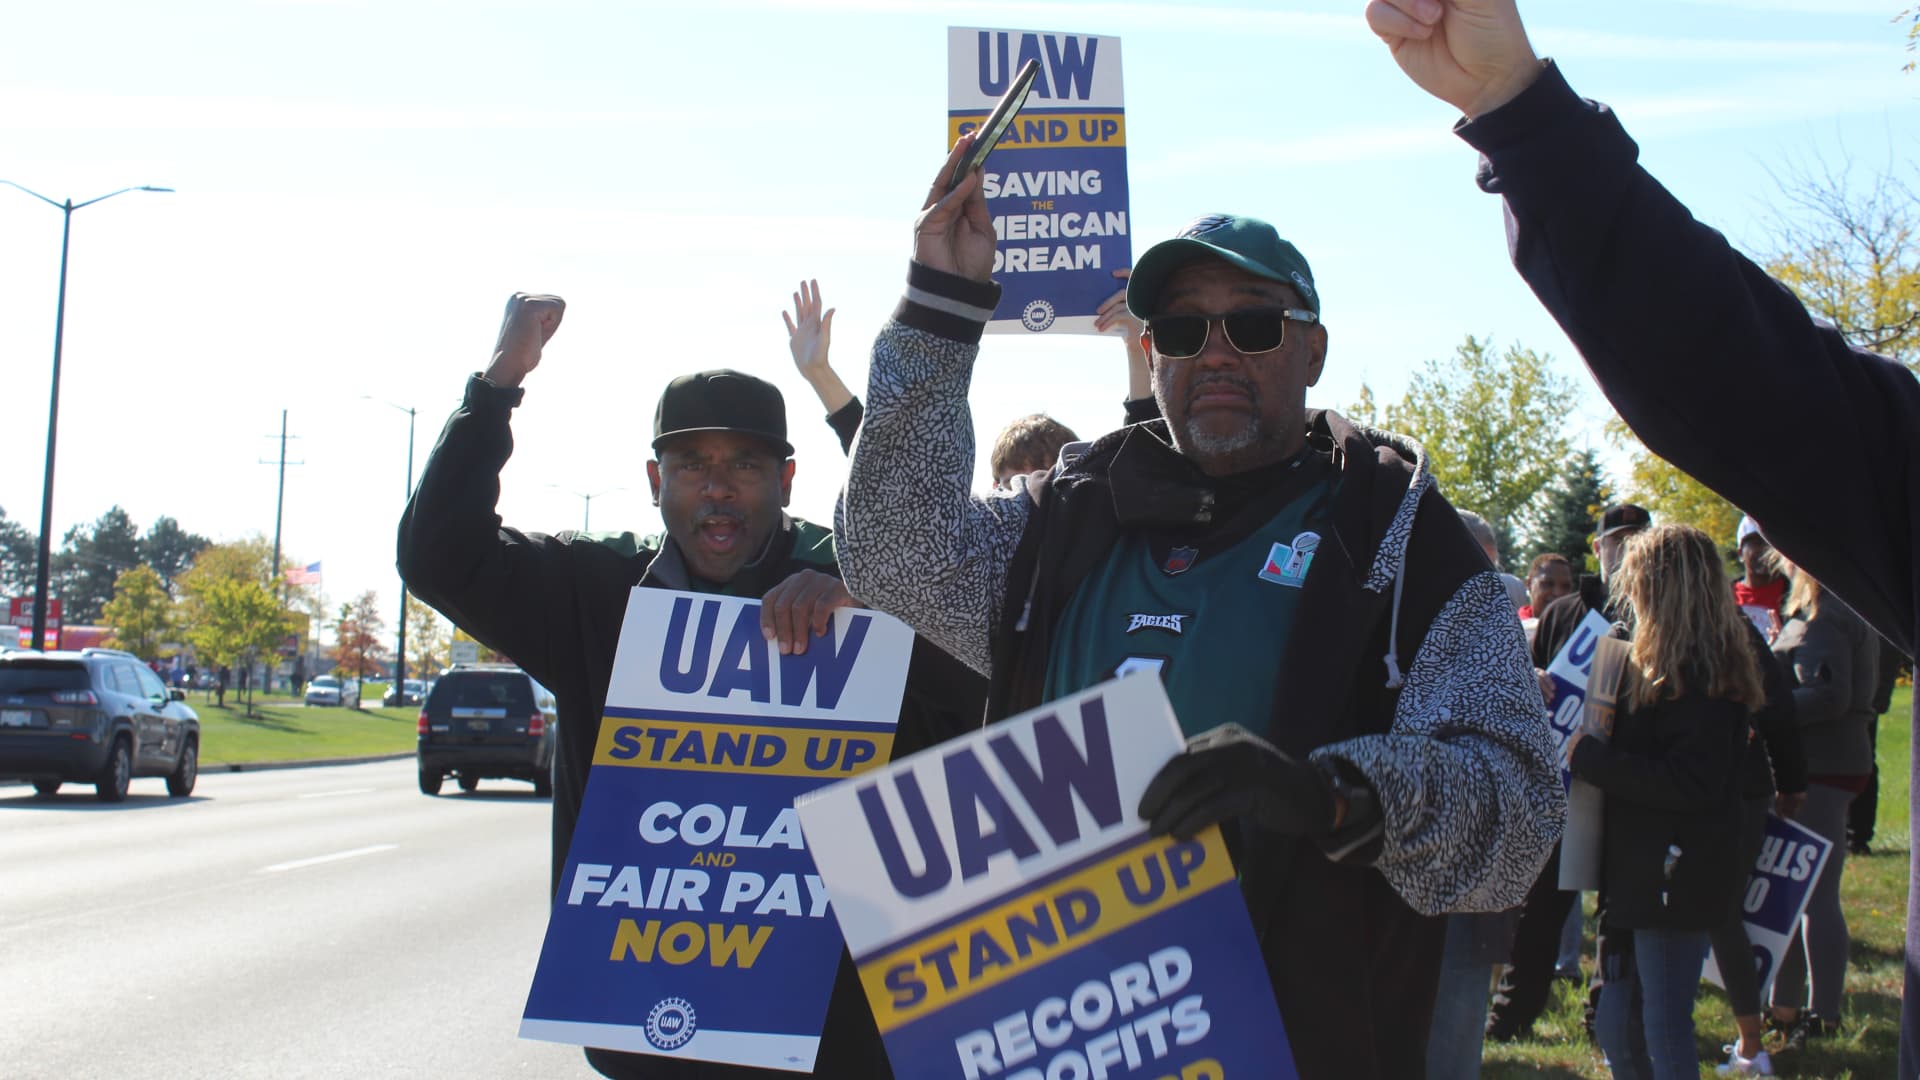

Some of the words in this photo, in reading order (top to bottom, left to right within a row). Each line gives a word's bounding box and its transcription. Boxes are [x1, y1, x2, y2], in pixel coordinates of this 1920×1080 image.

[978, 31, 1098, 101] UAW
[958, 119, 1069, 144] SAND
[1079, 118, 1118, 142] UP
[983, 169, 1102, 199] SAVING
[1032, 201, 1055, 211] THE
[992, 211, 1126, 241] MERICAN
[1031, 311, 1046, 319] UAW
[1125, 613, 1190, 633] EAGLES
[659, 596, 872, 710] UAW
[608, 726, 787, 769] STAND
[804, 736, 876, 773] UP
[857, 693, 1123, 899] UAW
[638, 801, 804, 850] COLA
[690, 852, 736, 868] AND
[567, 864, 710, 912] FAIR
[610, 919, 773, 969] NOW
[885, 888, 1101, 1010] STAND
[1117, 840, 1206, 907] UP
[660, 1016, 682, 1029] UAW
[955, 946, 1192, 1080] RECORD
